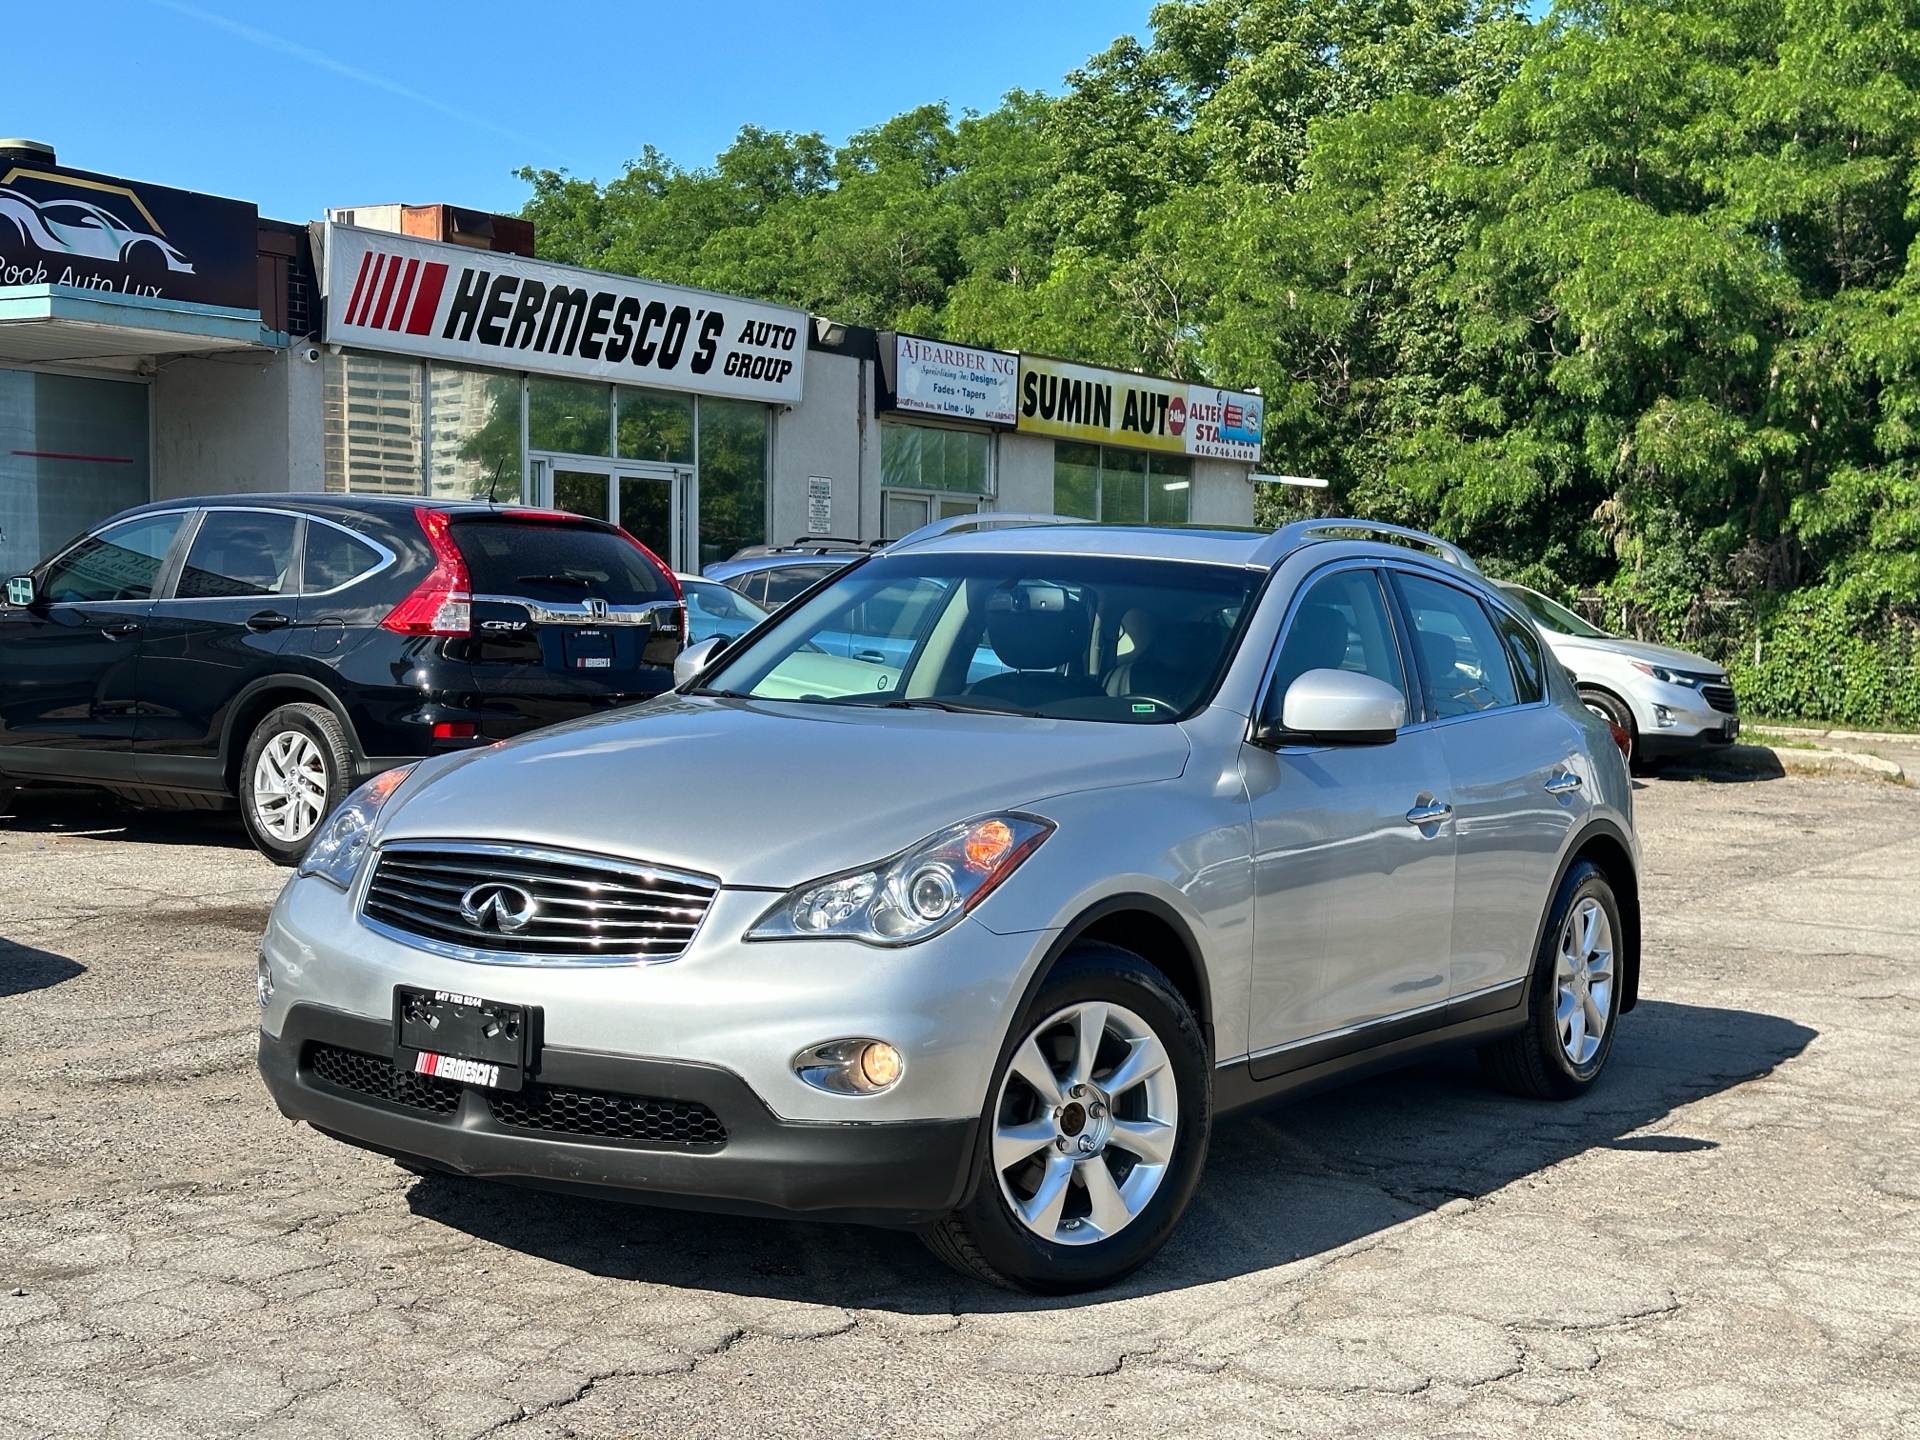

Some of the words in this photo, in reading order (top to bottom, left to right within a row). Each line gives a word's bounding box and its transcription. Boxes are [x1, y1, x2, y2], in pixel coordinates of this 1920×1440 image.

[57, 266, 114, 292] Auto
[122, 275, 163, 298] Lux
[442, 268, 725, 375] HERMESCO'S
[738, 319, 797, 350] AUTO
[723, 351, 793, 384] GROUP
[970, 372, 998, 386] Designs
[933, 383, 955, 395] Fades
[962, 387, 986, 400] Tapers
[1022, 371, 1112, 428] SUMIN
[1121, 389, 1169, 436] AUT
[944, 402, 959, 412] Line
[965, 405, 975, 416] Up
[1194, 444, 1254, 460] 416.746.1400
[436, 1054, 499, 1087] HERMESCO'S
